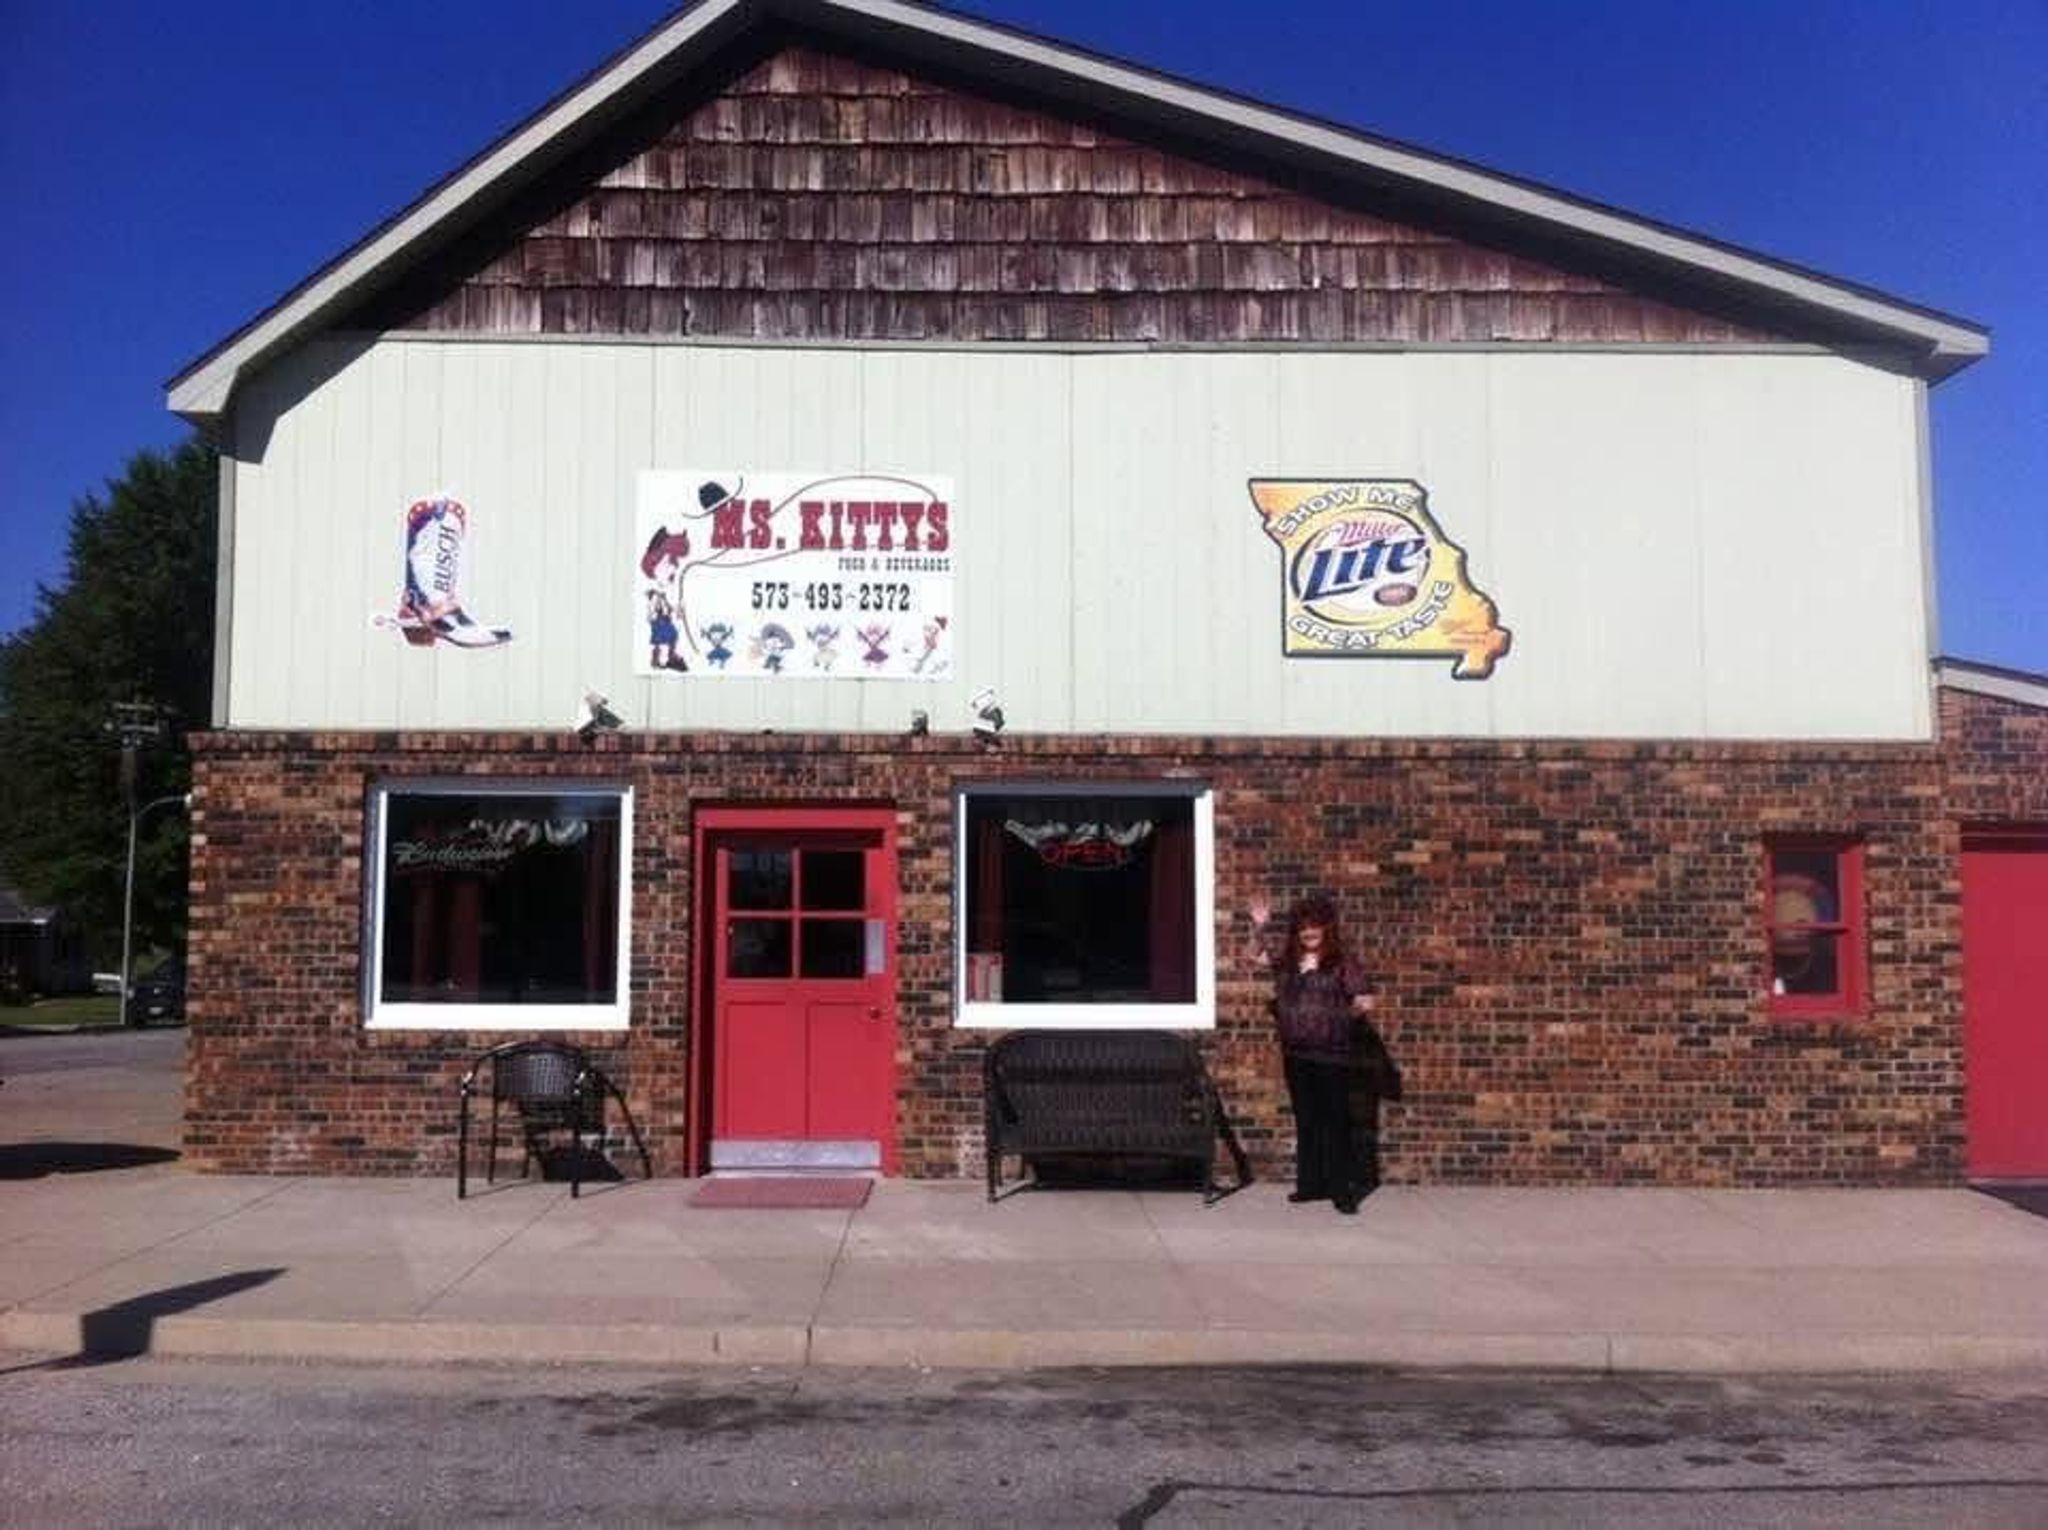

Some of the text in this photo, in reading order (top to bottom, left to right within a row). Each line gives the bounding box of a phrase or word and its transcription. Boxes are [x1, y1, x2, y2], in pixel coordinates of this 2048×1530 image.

[711, 499, 950, 552] MS. KITTYS
[1277, 487, 1417, 536] SHOW ME
[1331, 519, 1408, 548] Miller
[433, 524, 459, 593] BUSCH
[1301, 536, 1426, 602] Lite
[1289, 615, 1383, 650] GREAT
[1387, 579, 1454, 640] TASTE
